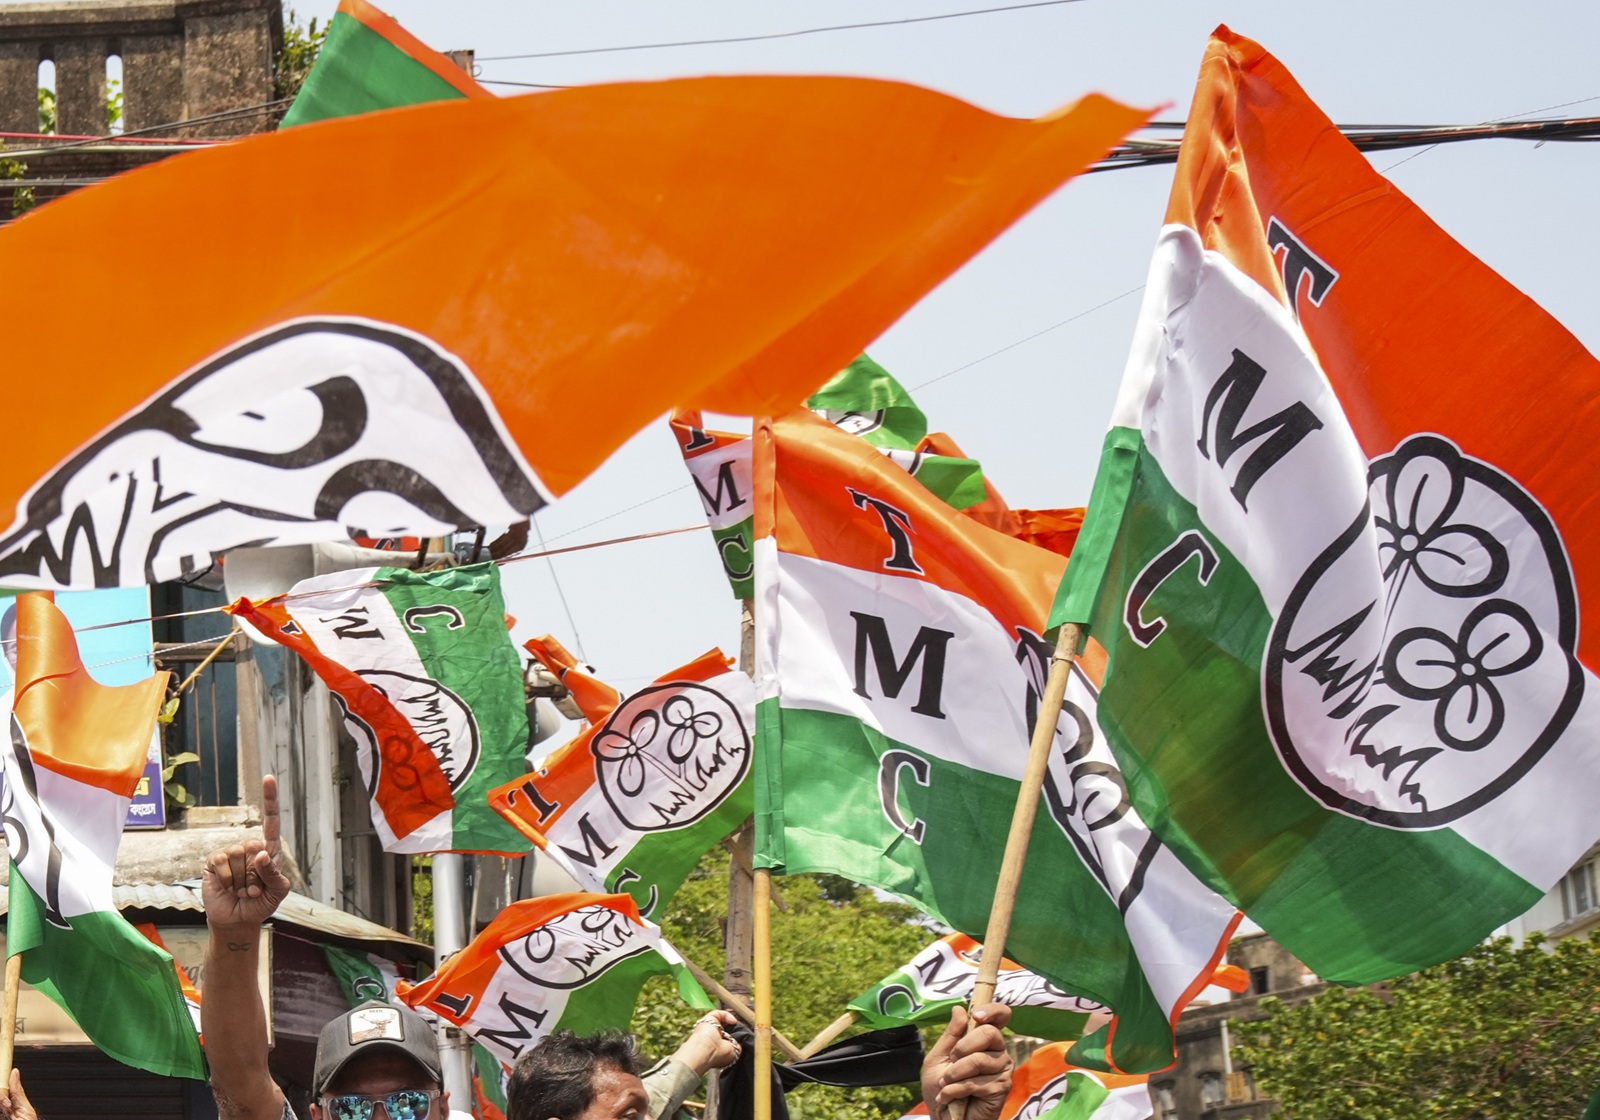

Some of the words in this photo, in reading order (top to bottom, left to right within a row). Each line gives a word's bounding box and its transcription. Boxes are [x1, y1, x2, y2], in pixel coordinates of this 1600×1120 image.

[1266, 214, 1340, 320] T
[1197, 347, 1324, 514] M
[692, 459, 747, 518] M
[844, 486, 926, 576] T
[716, 533, 754, 582] C
[1123, 529, 1221, 649] C
[319, 605, 386, 640] M
[403, 603, 465, 634] C
[849, 610, 955, 720] M
[507, 768, 561, 825] T
[556, 812, 618, 868] M
[877, 748, 932, 846] C
[913, 950, 978, 995] M
[474, 992, 549, 1060] M
